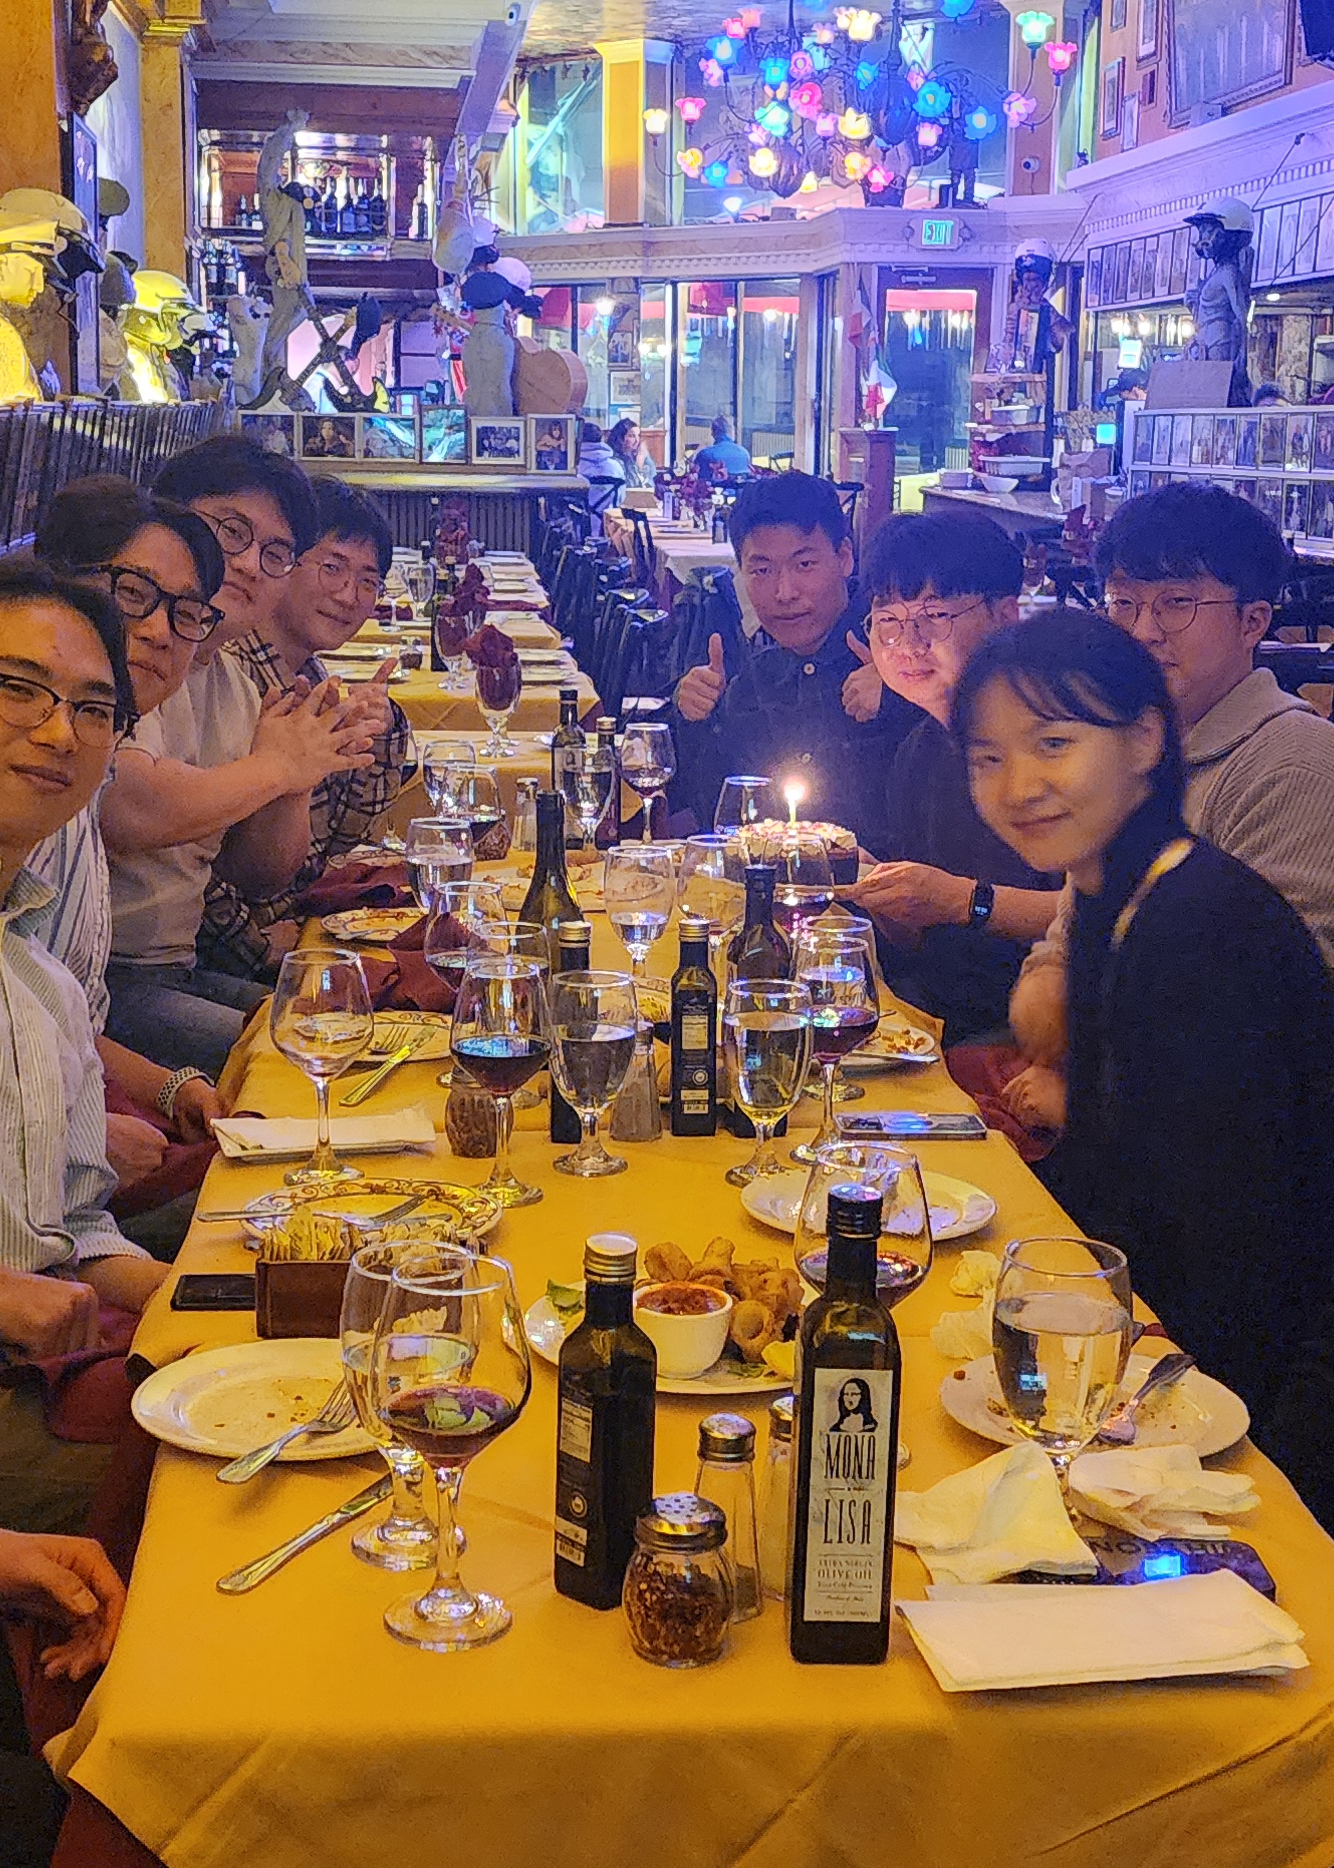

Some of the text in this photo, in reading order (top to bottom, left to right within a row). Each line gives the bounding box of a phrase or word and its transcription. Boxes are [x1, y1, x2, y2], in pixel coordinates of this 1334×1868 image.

[923, 220, 954, 245] EXIT
[824, 1434, 876, 1480] MONA
[823, 1498, 872, 1545] LISA
[817, 1569, 872, 1580] OLIVE OIL
